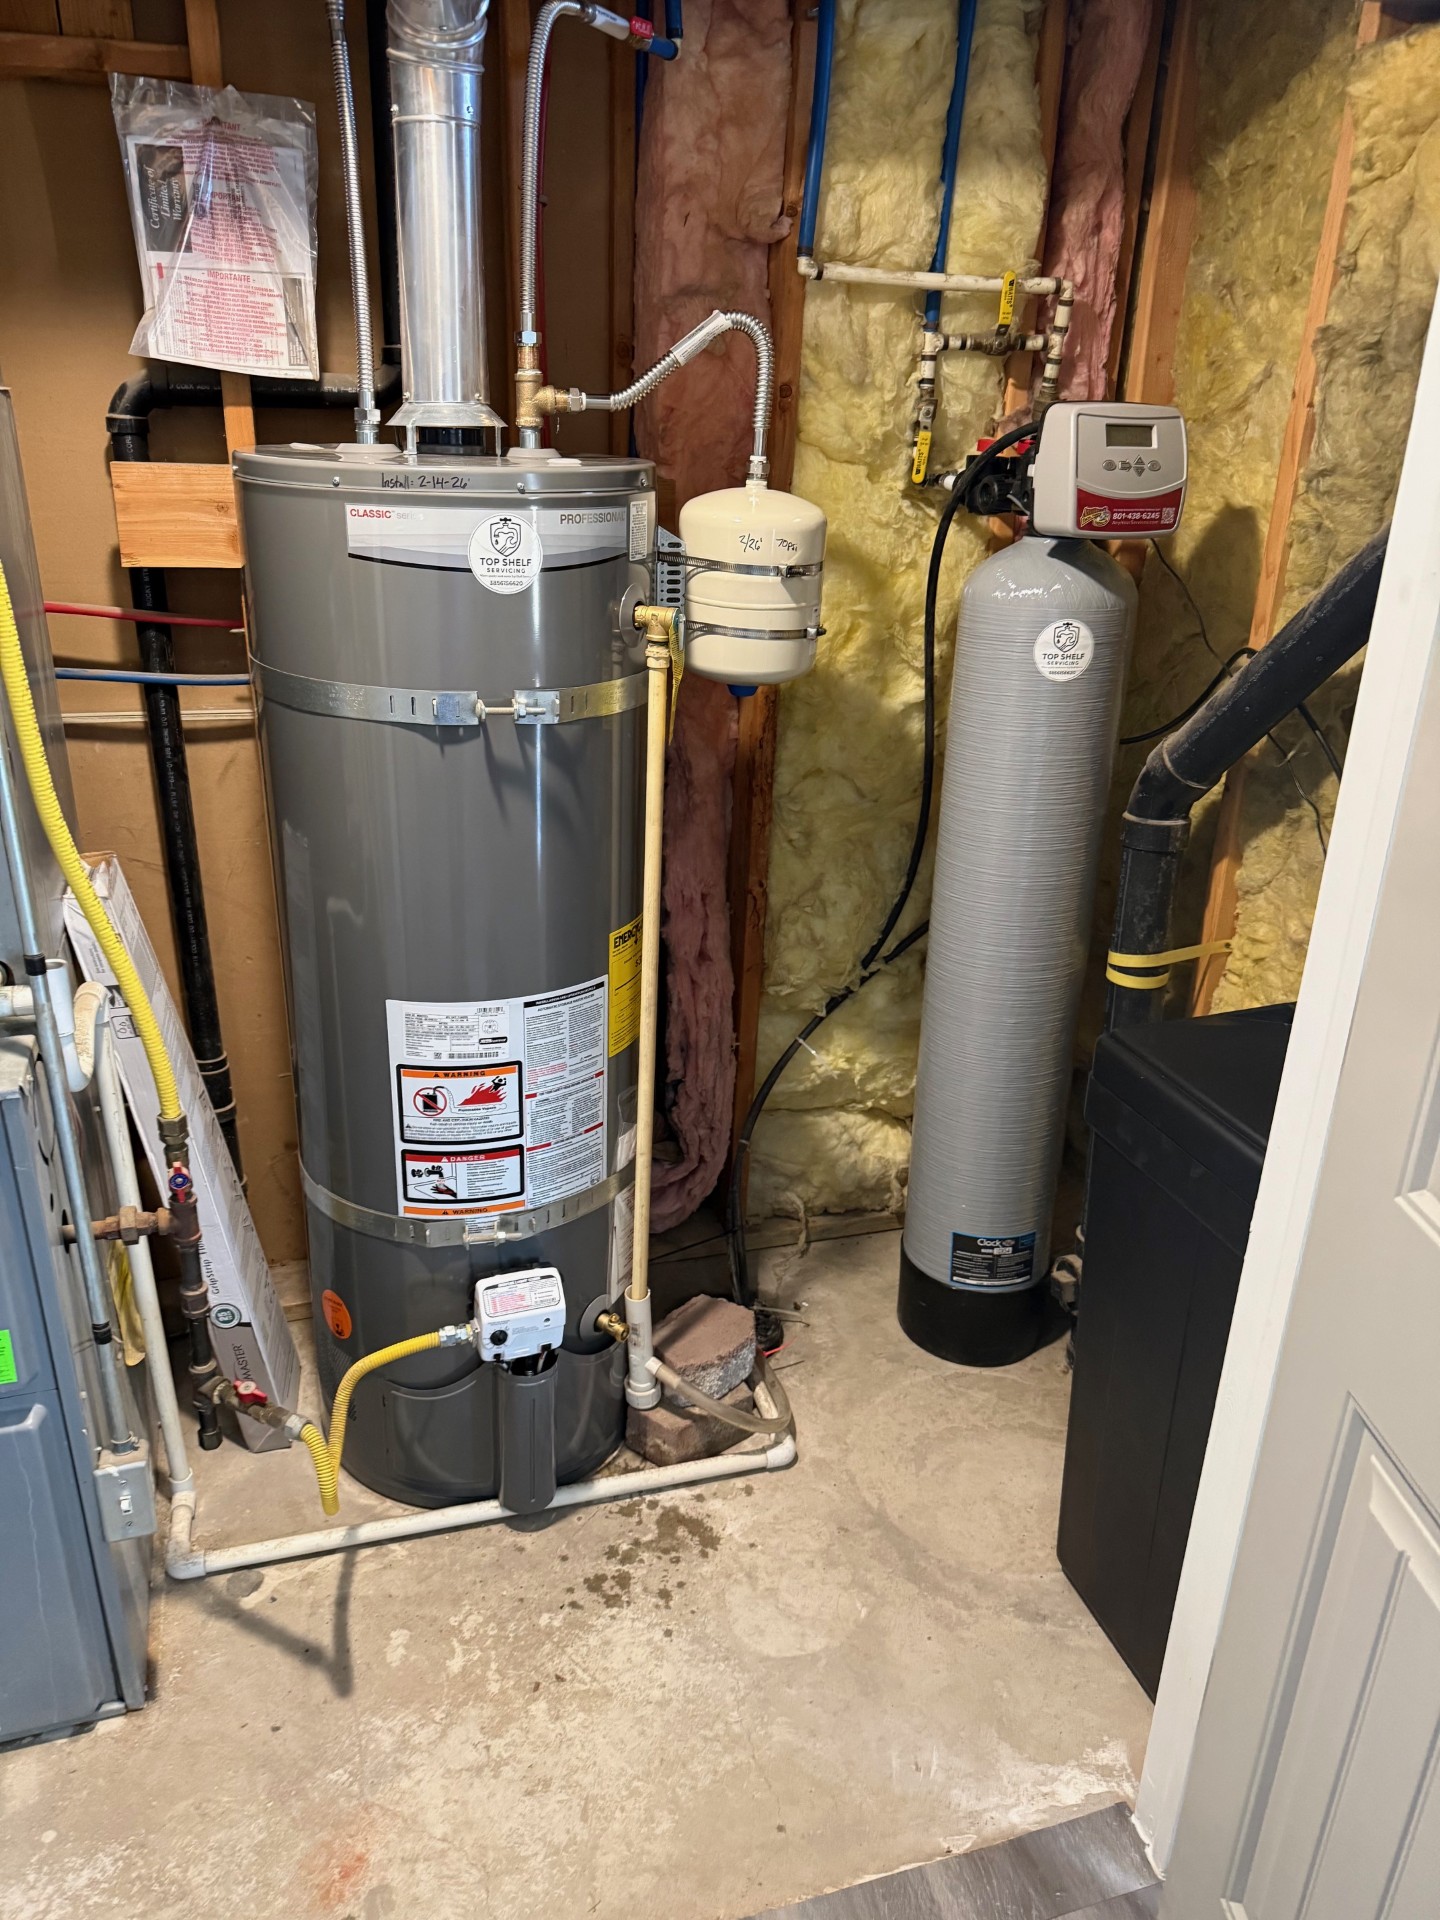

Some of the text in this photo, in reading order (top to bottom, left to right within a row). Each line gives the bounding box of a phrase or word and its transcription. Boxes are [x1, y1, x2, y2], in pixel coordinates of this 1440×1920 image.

[148, 175, 161, 229] Certificate
[160, 180, 171, 218] Limited
[172, 177, 183, 221] Warranty
[207, 270, 251, 283] IMPORTANTE
[396, 511, 424, 520] seris
[480, 557, 532, 567] TOP SHELF
[443, 1070, 486, 1079] WARNING
[450, 1153, 486, 1162] DANGER
[452, 1206, 489, 1216] WARNING
